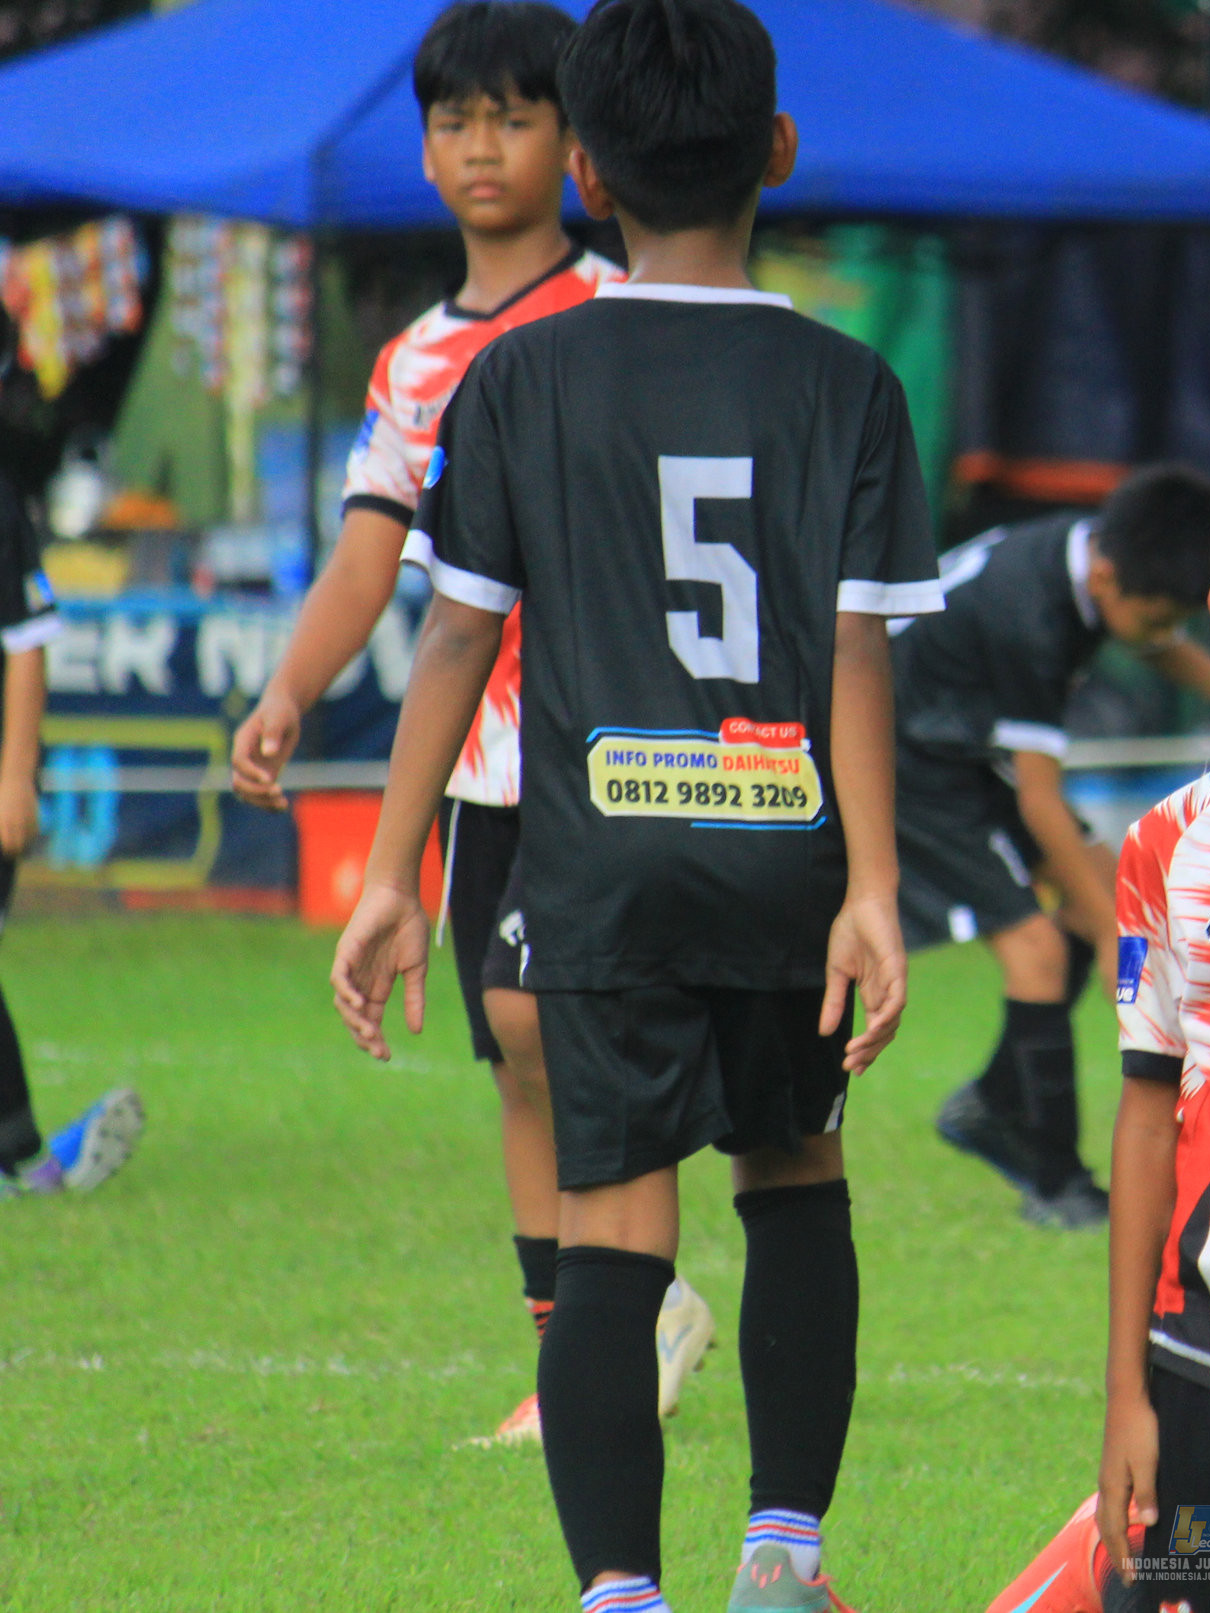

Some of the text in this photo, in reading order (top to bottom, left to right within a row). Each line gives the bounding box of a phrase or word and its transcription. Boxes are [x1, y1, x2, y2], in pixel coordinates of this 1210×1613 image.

[657, 455, 760, 684] 5
[605, 750, 647, 767] INFO
[653, 752, 718, 769] PROMO
[606, 779, 808, 808] 0812 9892 3209
